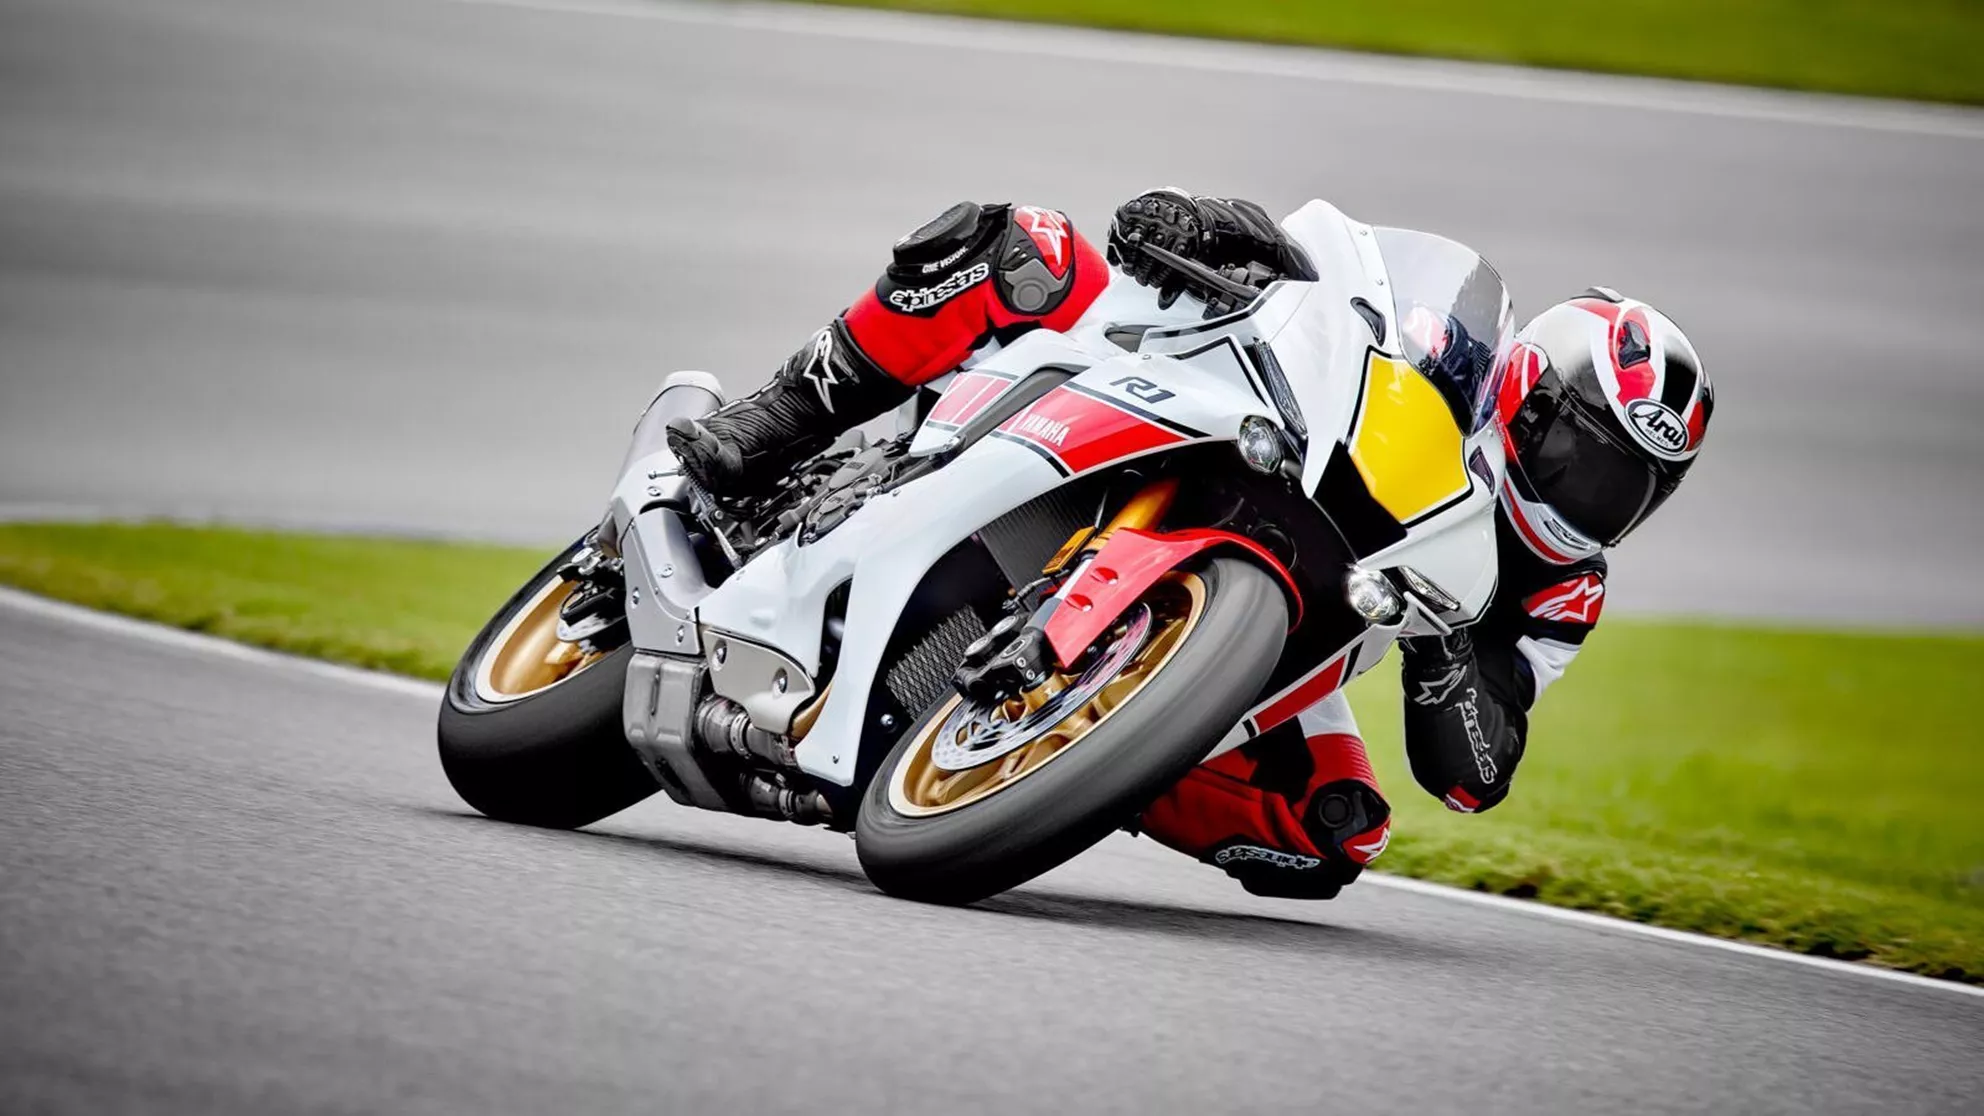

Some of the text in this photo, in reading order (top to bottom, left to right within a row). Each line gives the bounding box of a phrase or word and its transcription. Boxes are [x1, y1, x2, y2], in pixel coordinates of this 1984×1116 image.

[1109, 376, 1176, 404] R1
[1020, 413, 1070, 447] YAMAHA
[1630, 409, 1686, 446] Arai
